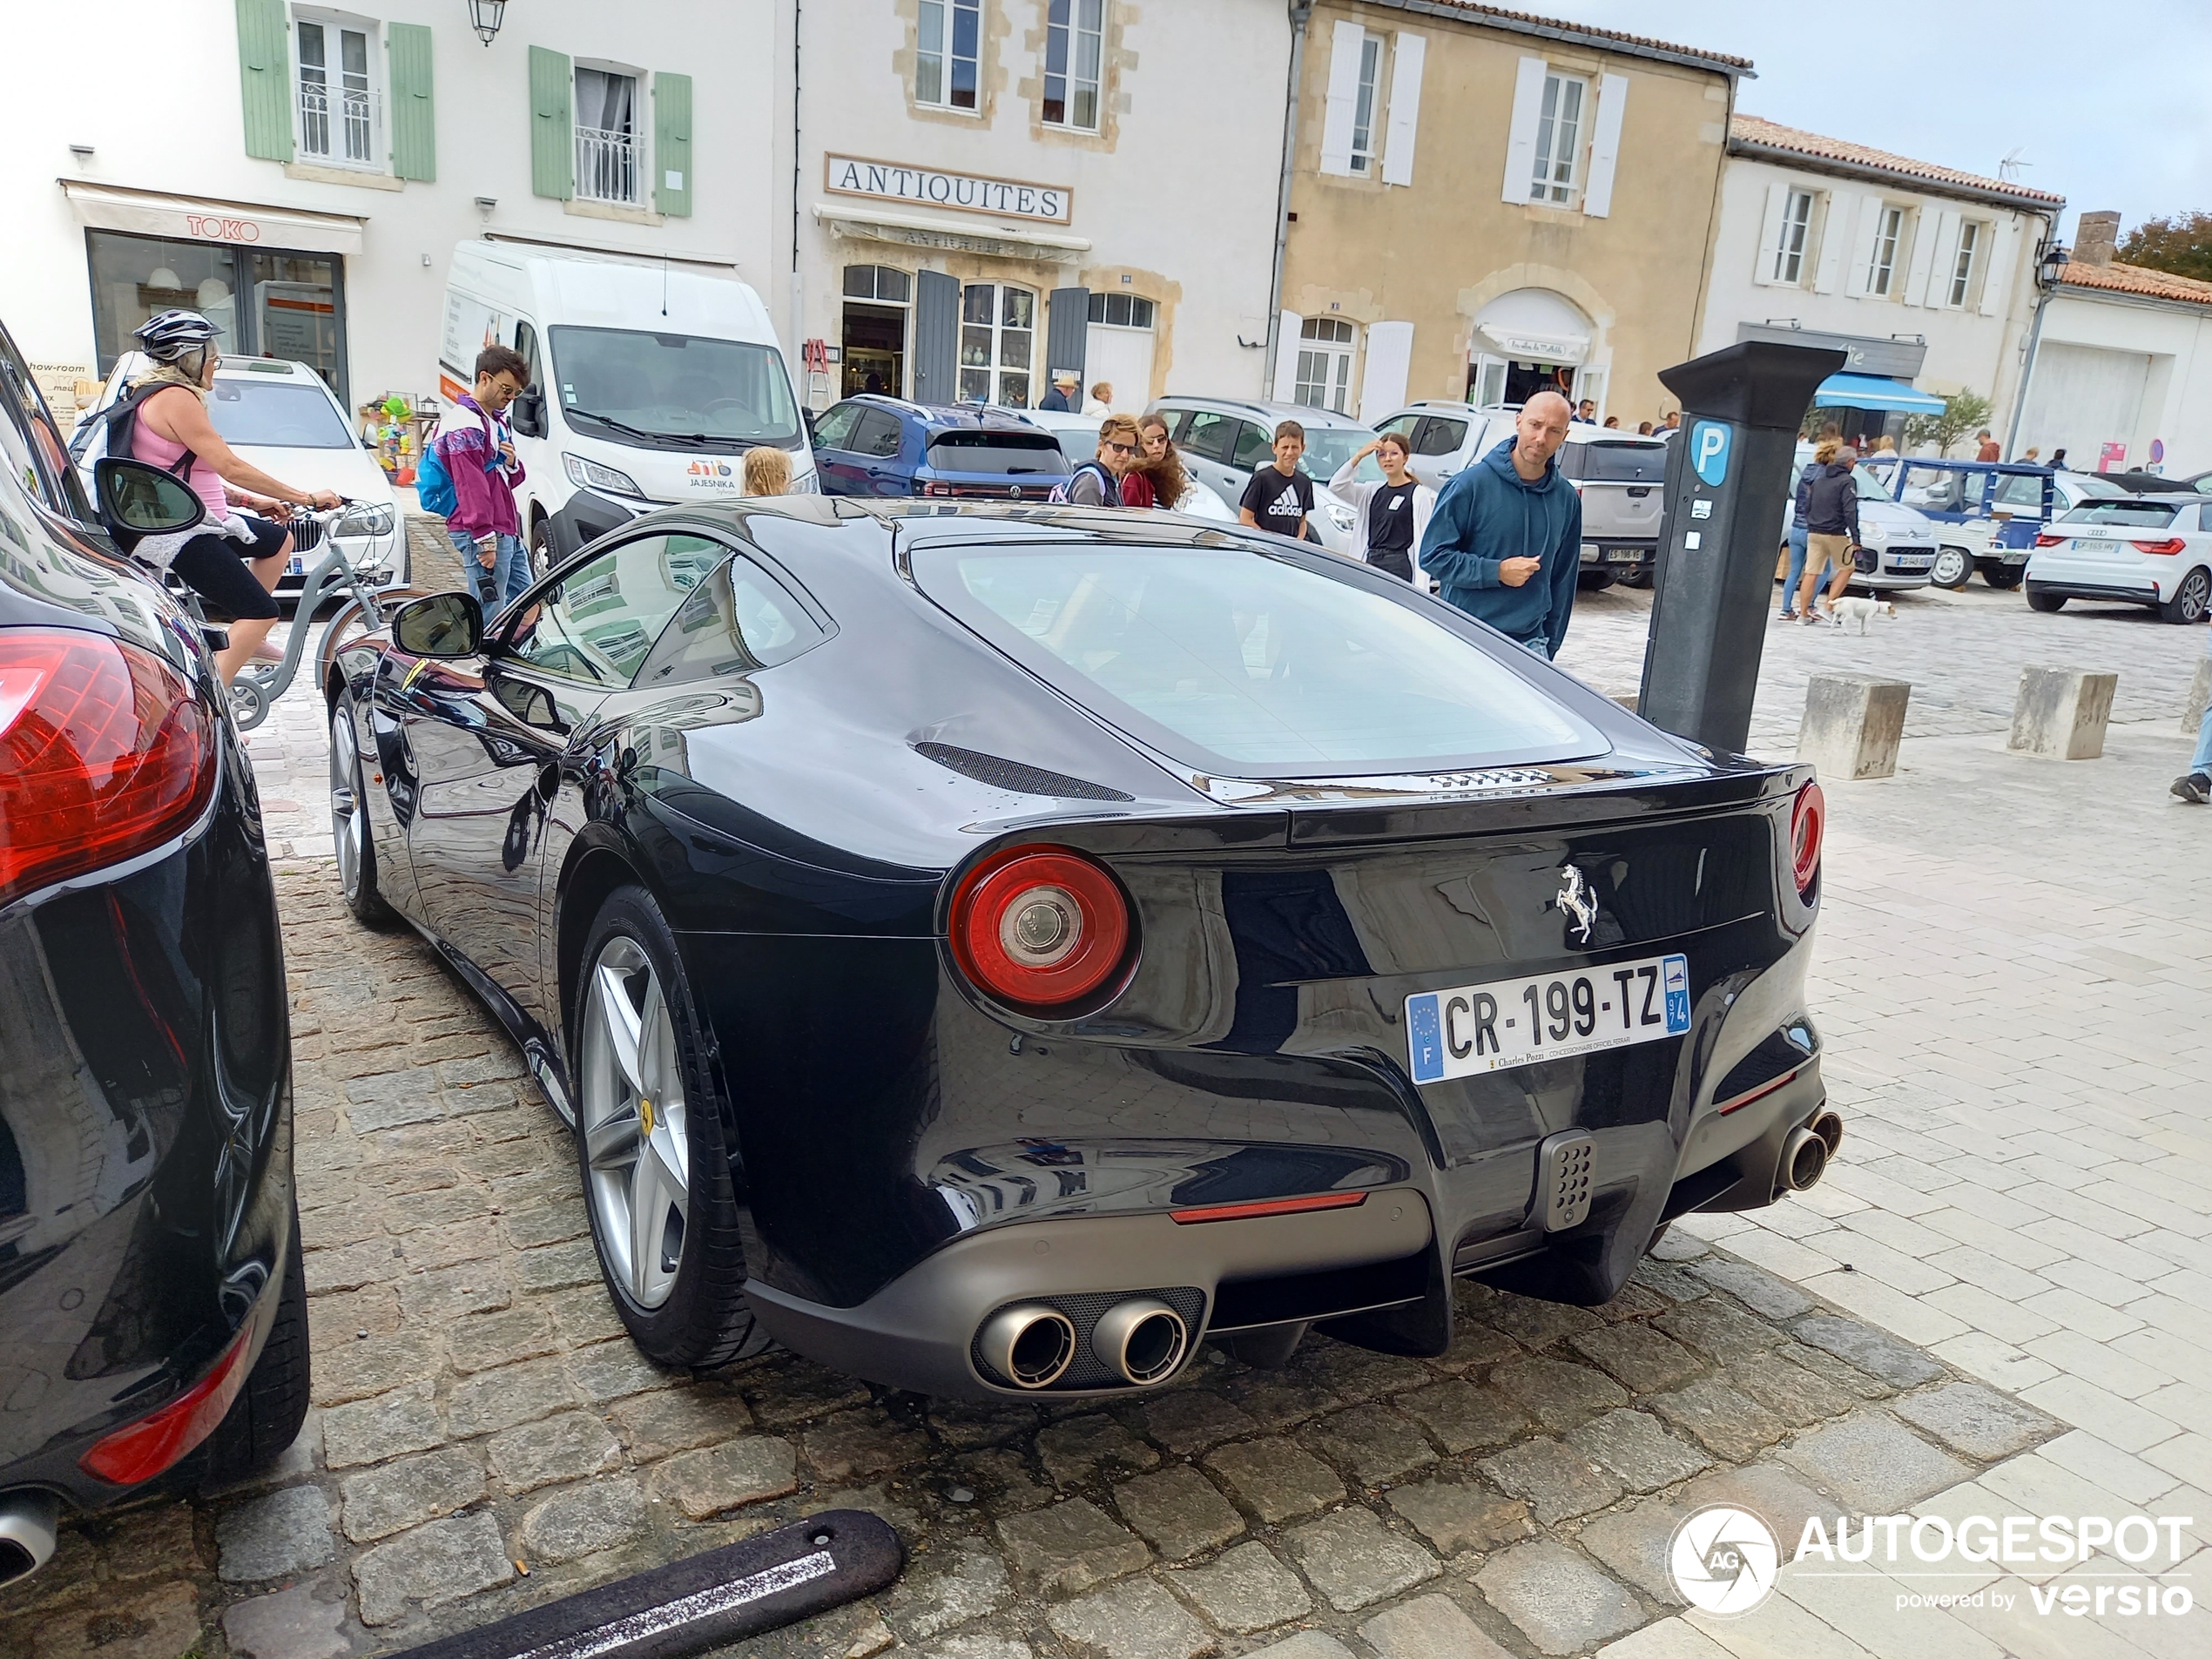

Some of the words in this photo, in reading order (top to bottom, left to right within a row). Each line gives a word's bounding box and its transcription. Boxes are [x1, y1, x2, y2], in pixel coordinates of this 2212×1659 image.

[840, 162, 1058, 217] ANTIQUITES
[186, 215, 260, 242] TOKO
[1696, 428, 1724, 474] P
[1268, 503, 1303, 517] adidas
[1422, 1047, 1433, 1065] F
[1445, 965, 1662, 1060] CR-199-TZ
[1498, 1055, 1525, 1068] Charles
[1526, 1052, 1545, 1062] Pozzi
